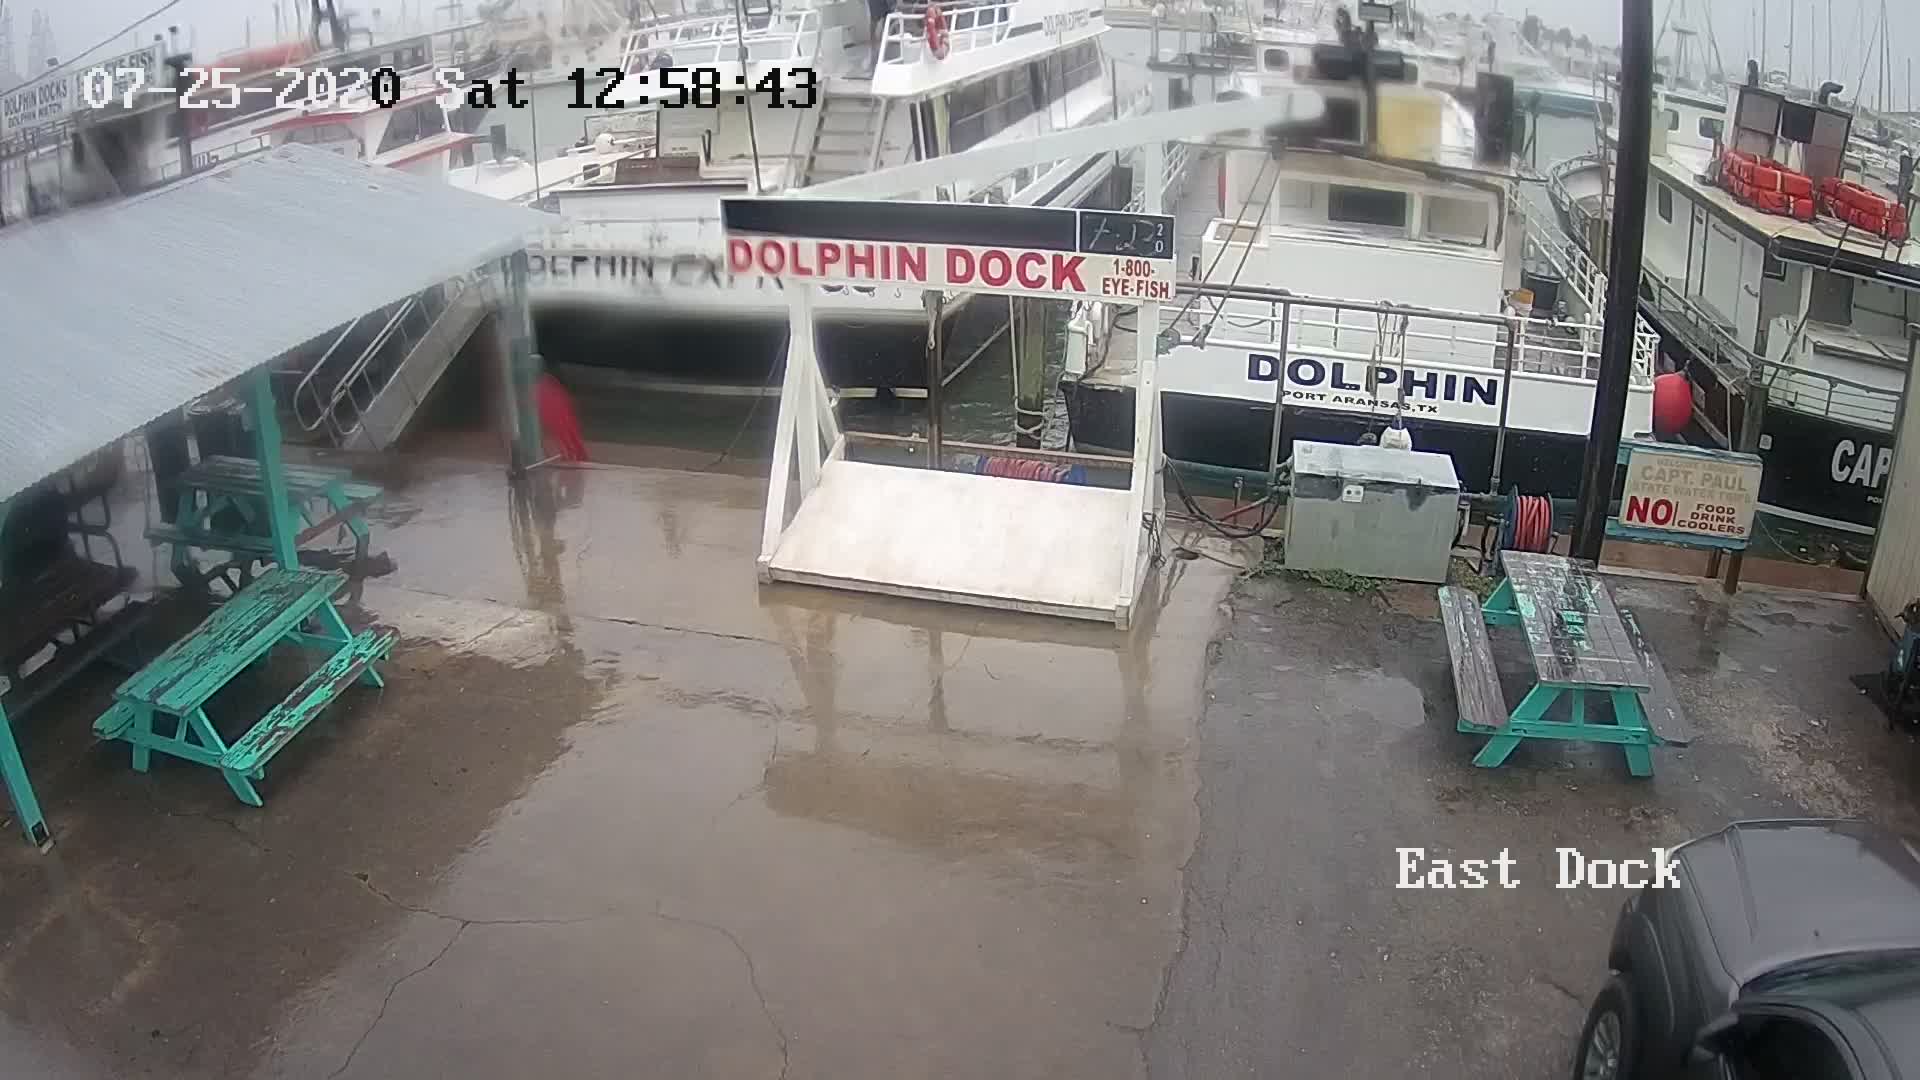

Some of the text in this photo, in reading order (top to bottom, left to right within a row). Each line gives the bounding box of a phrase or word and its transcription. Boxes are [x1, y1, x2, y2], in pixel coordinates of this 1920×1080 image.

[729, 239, 927, 282] DOLPHIN
[946, 248, 1086, 292] DOCK
[1113, 258, 1155, 277] 1-800-
[1102, 277, 1169, 299] EYE-FISH
[1247, 353, 1498, 406] DOLPHIN
[1282, 390, 1327, 401] PORT
[1641, 465, 1694, 485] CAPT.
[1700, 472, 1748, 491] PAUL
[1626, 495, 1673, 526] NO
[1690, 511, 1736, 525] DRINK
[1696, 503, 1736, 515] FOOD
[1677, 519, 1746, 535] COOLERS
